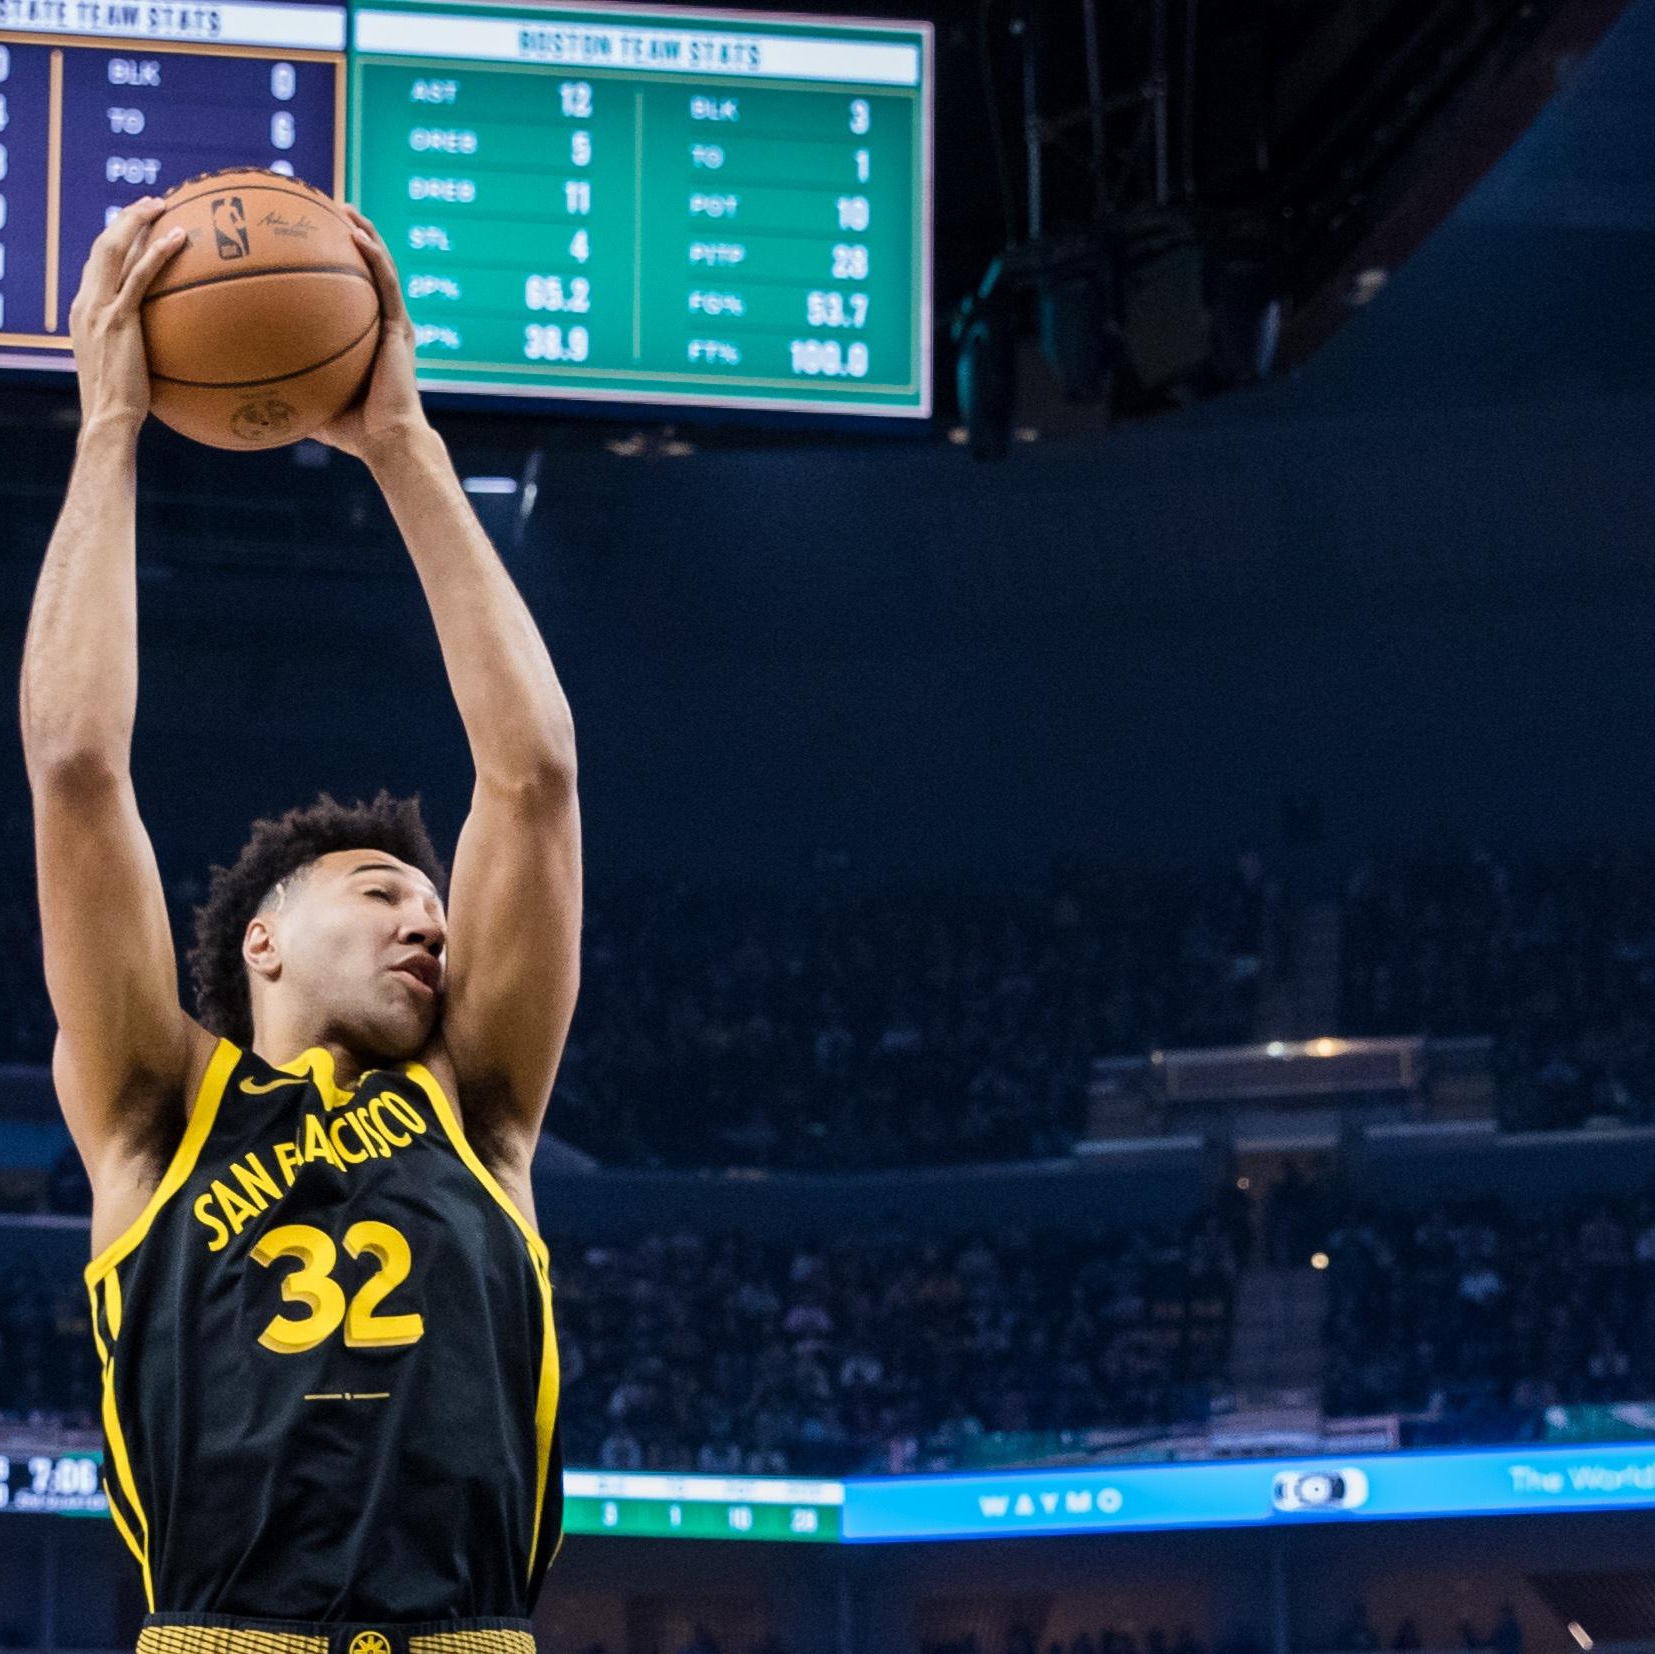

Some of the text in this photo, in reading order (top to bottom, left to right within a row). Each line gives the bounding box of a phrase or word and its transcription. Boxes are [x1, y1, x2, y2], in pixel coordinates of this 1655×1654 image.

[854, 148, 870, 184] 1
[569, 229, 589, 264] 4
[193, 1151, 285, 1252] SAN
[249, 1220, 425, 1354] 32
[1508, 1465, 1564, 1493] The
[978, 1487, 1123, 1518] WAYMO
